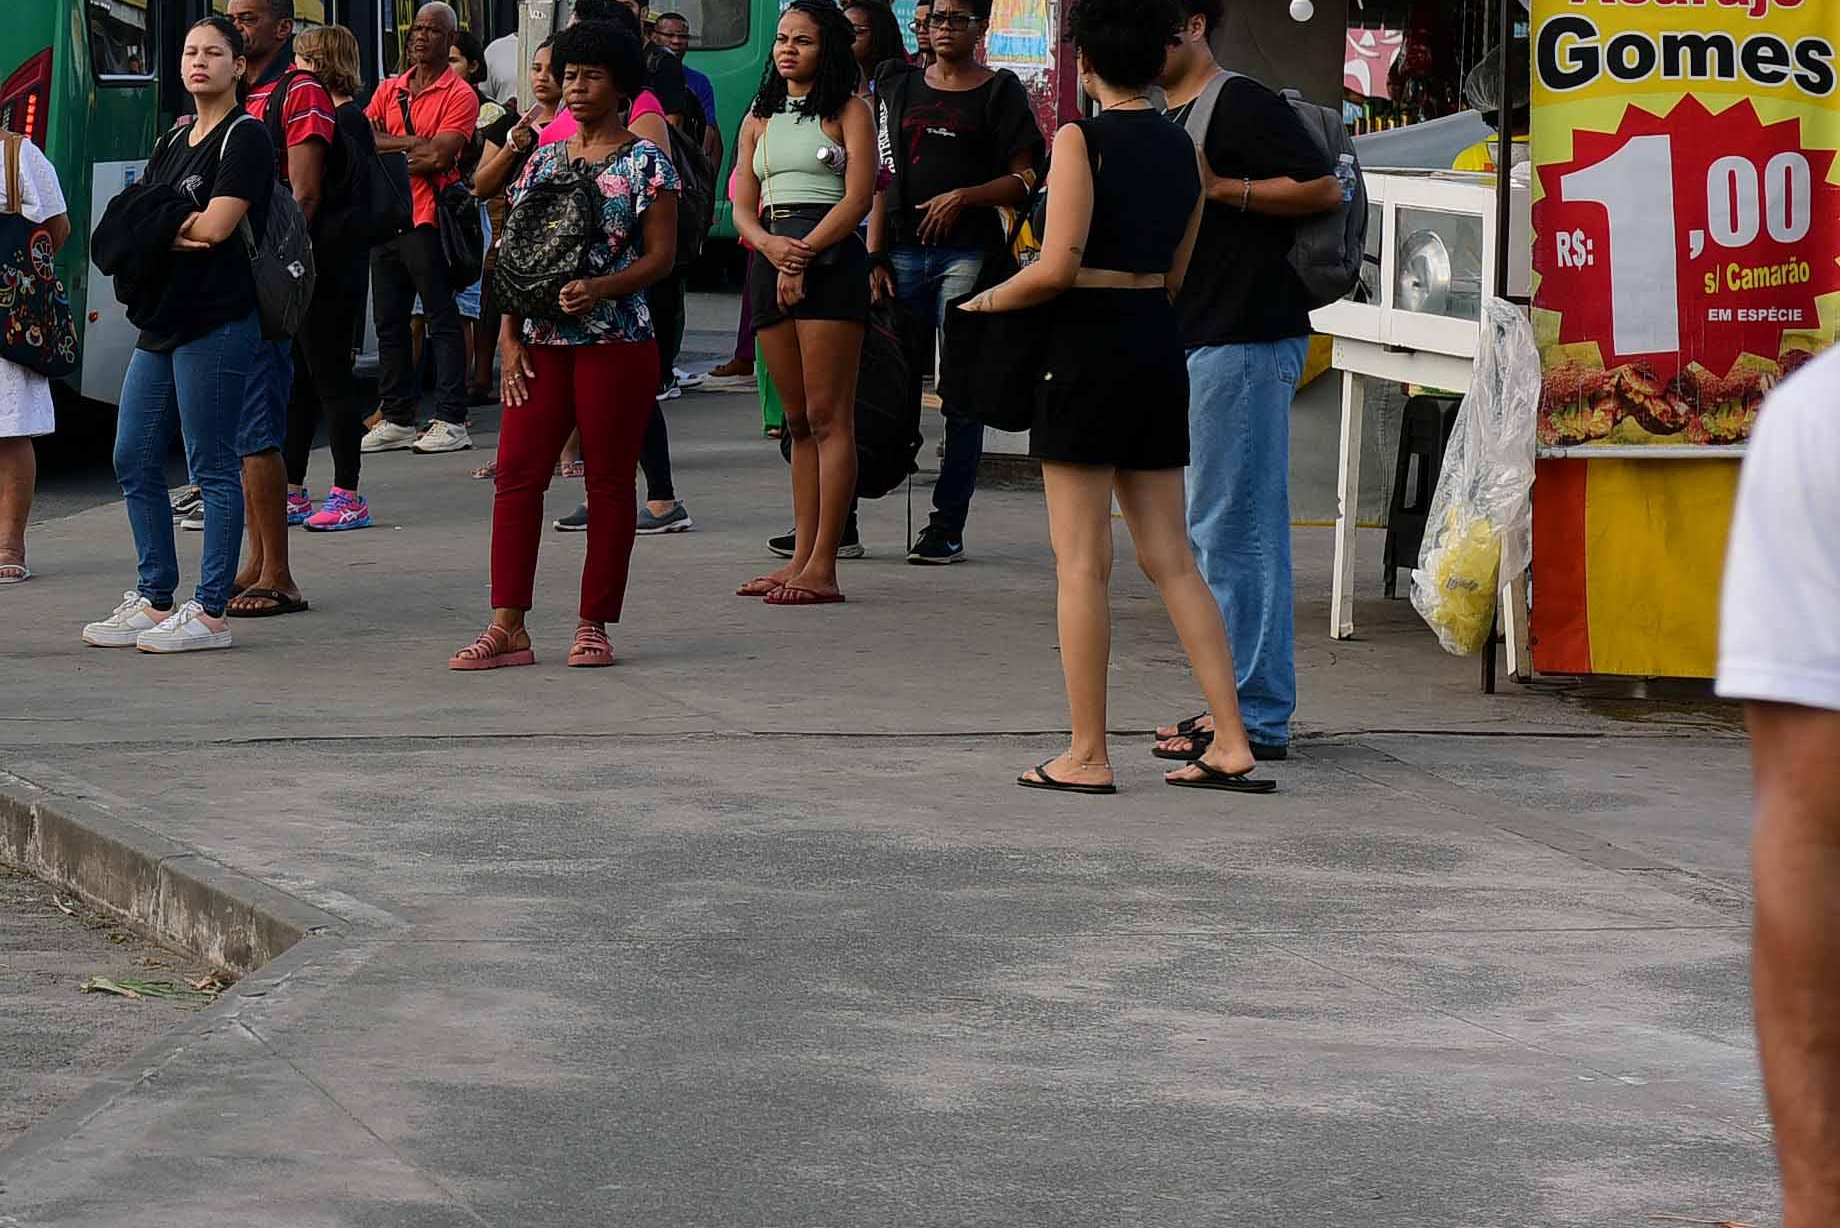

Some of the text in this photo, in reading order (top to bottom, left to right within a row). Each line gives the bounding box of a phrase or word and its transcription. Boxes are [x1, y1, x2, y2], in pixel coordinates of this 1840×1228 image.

[1536, 13, 1836, 97] Gomes
[1555, 228, 1595, 270] R$:
[1704, 255, 1810, 294] s/ Camarão
[1707, 306, 1803, 322] EM ESPÉCIE
